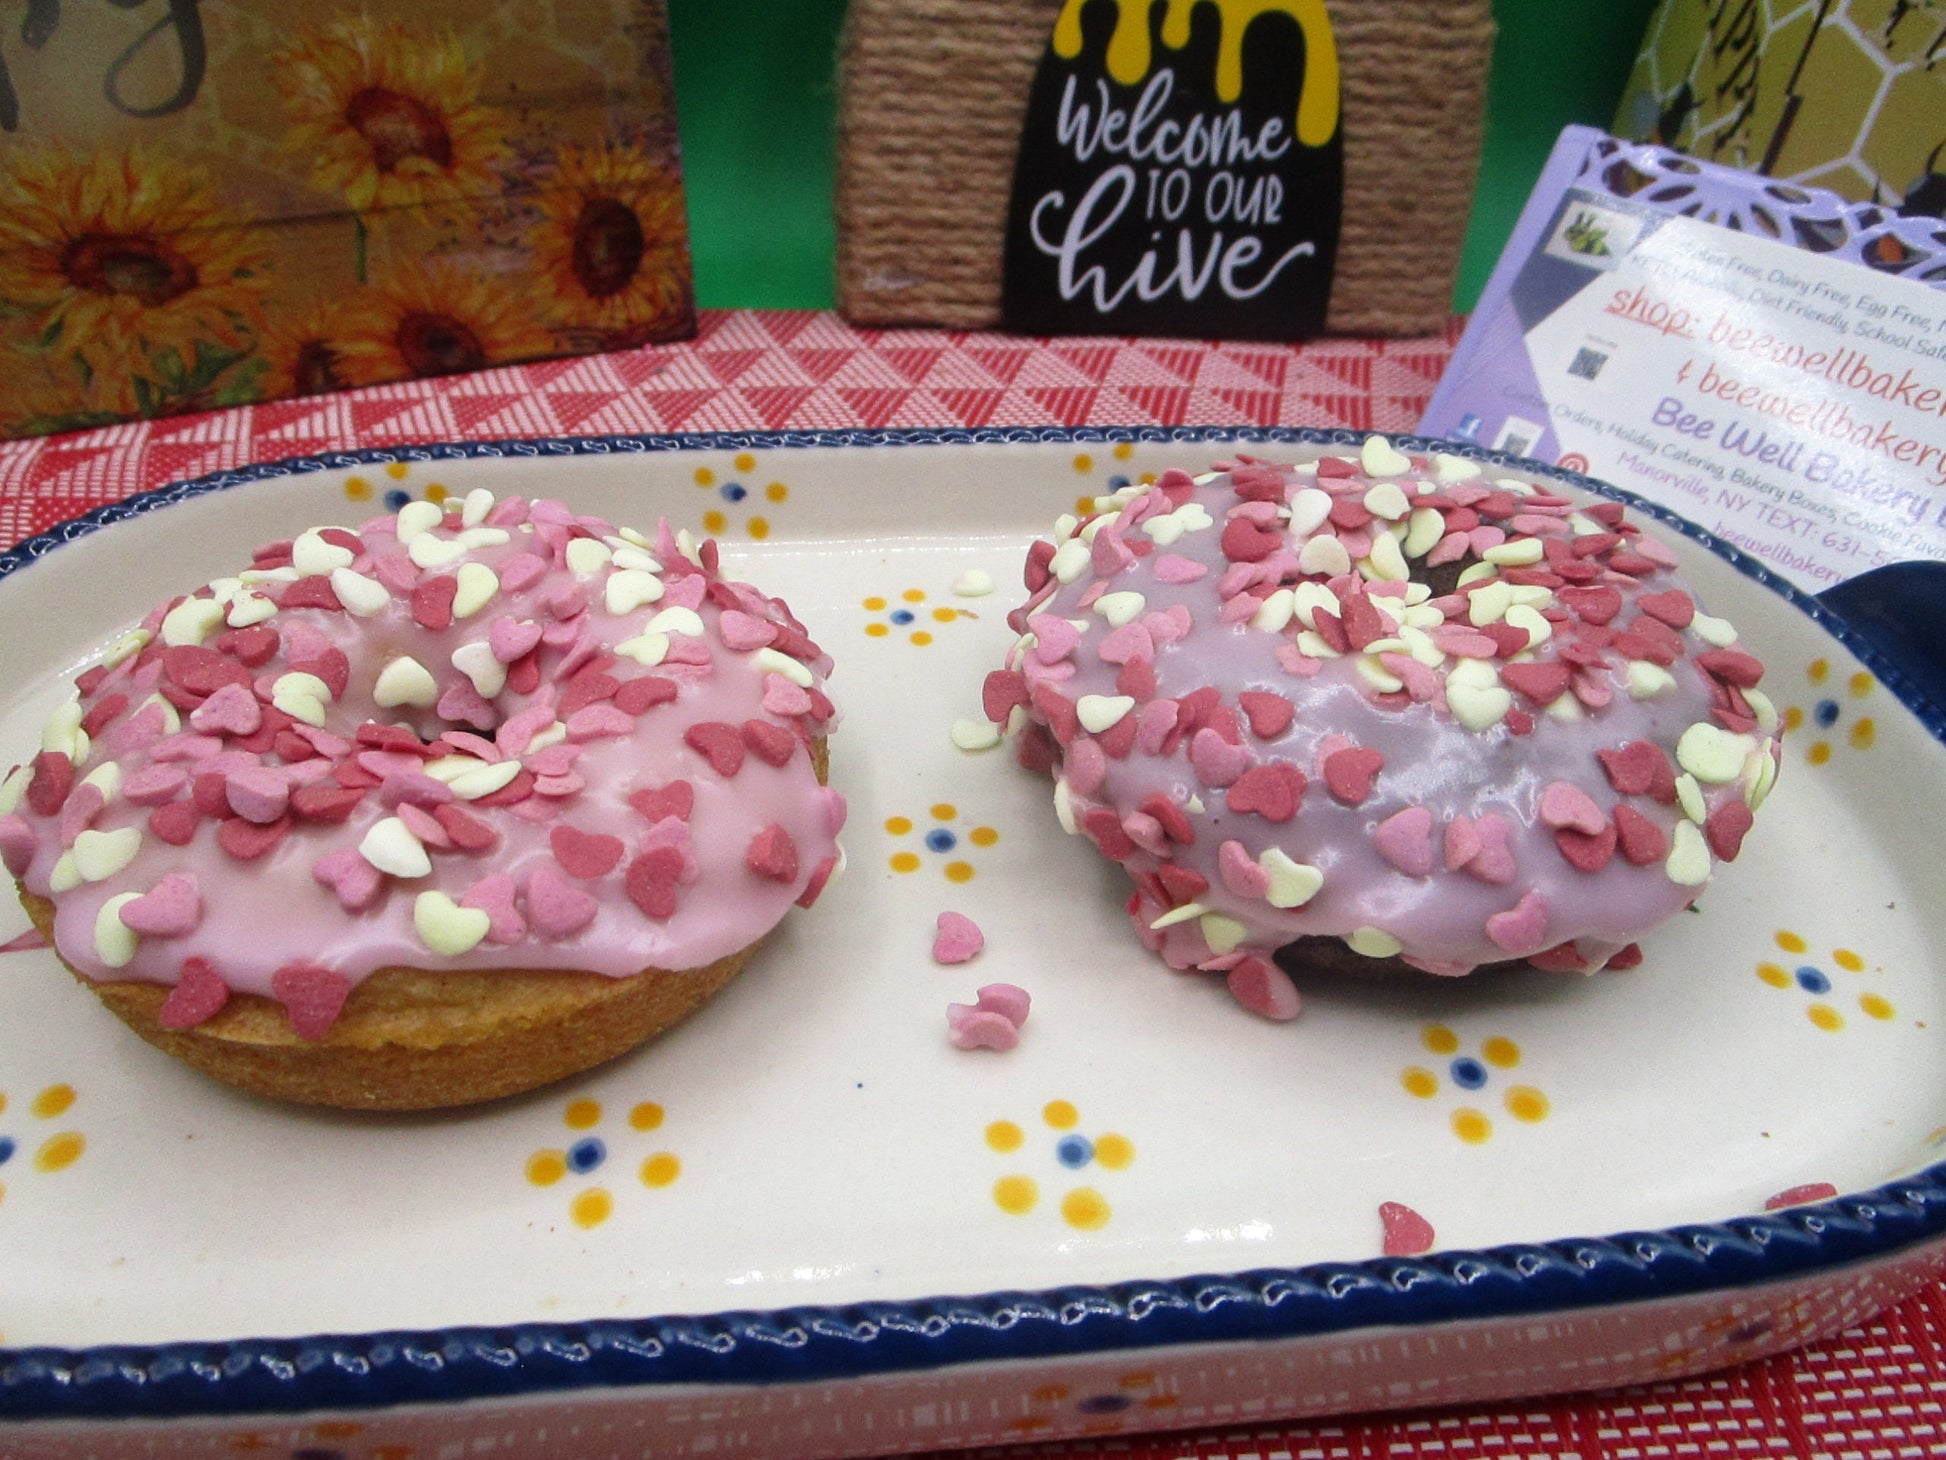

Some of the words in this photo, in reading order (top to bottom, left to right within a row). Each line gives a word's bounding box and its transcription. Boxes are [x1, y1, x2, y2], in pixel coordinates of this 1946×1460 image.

[1057, 68, 1292, 167] Welcome
[1030, 165, 1315, 313] hive
[1146, 169, 1191, 221] TO
[1205, 171, 1284, 225] OUR
[1604, 286, 1701, 338] shop:
[1767, 268, 1811, 298] Dairy
[1812, 281, 1851, 308] Free,
[1855, 294, 1888, 319] Egg
[1891, 304, 1931, 333] Free,
[1785, 301, 1848, 336] Friendly,
[1853, 320, 1914, 350] School
[1608, 422, 1660, 456] Holiday
[1662, 443, 1725, 481] Catering,
[1730, 467, 1785, 501] Bakery
[1789, 489, 1838, 524] Boxes,
[1617, 451, 1710, 504] Manorville,
[1716, 488, 1752, 513] NY
[1757, 502, 1819, 538] TEXT:
[1651, 396, 1715, 440] Bee
[1720, 420, 1804, 473] Well
[1805, 450, 1930, 527] Bakery
